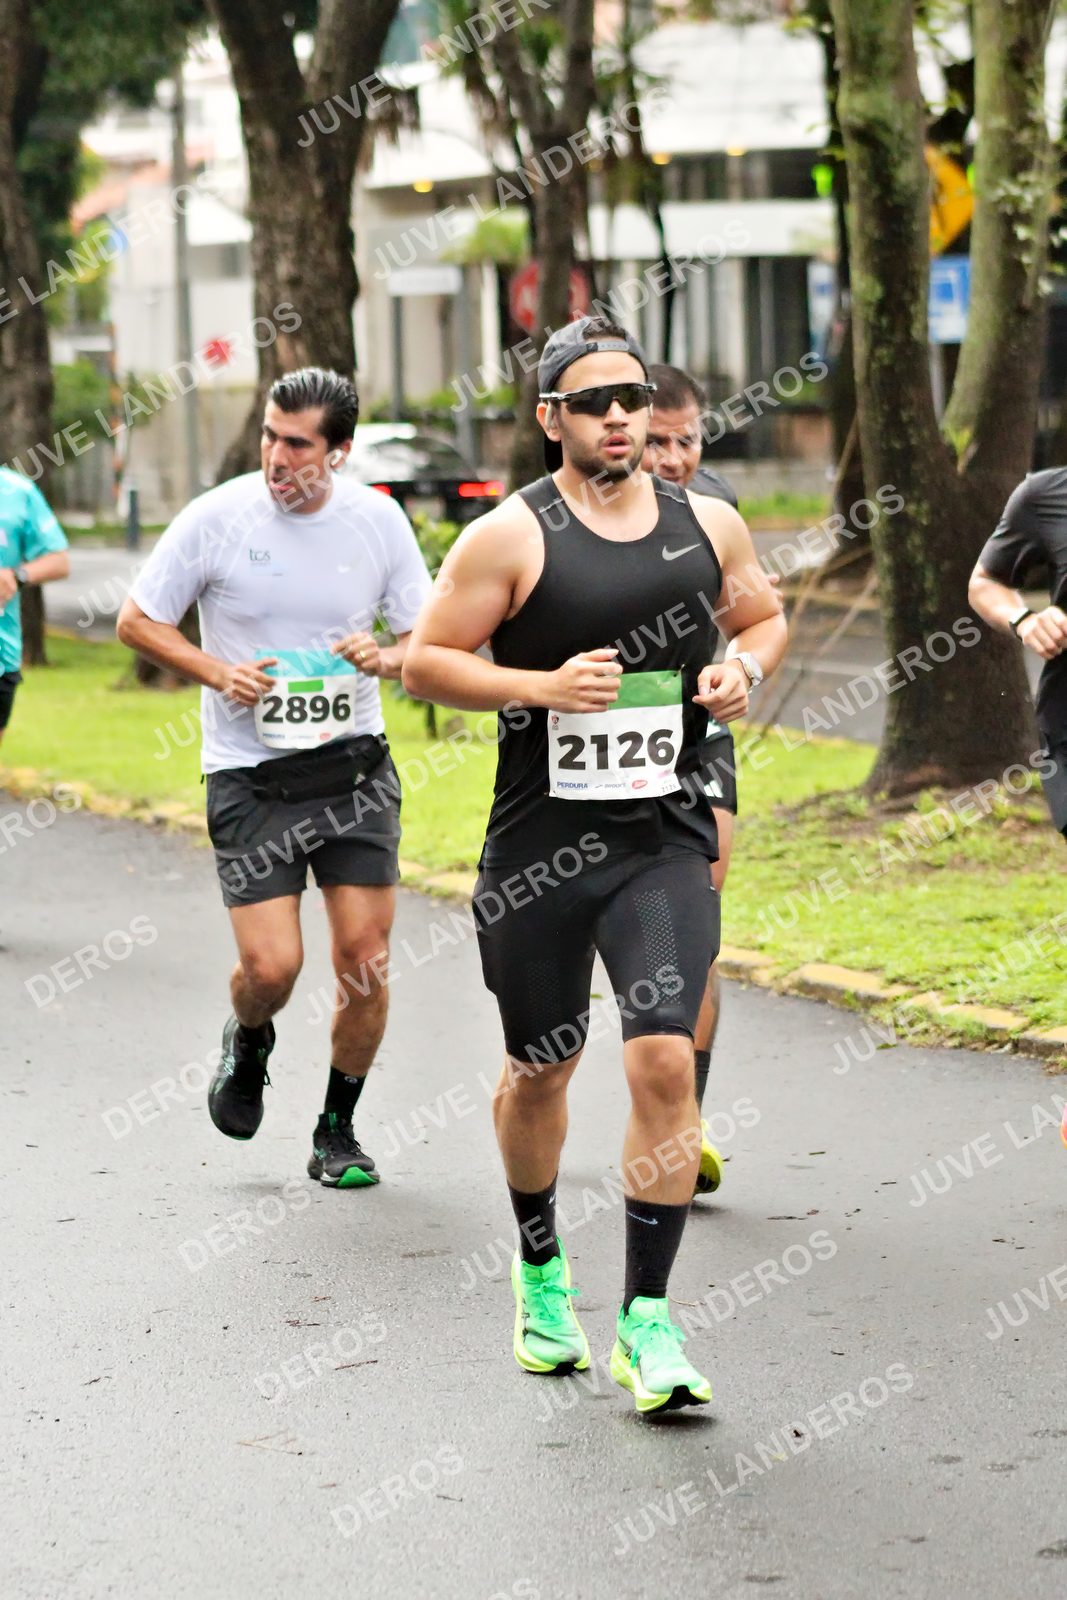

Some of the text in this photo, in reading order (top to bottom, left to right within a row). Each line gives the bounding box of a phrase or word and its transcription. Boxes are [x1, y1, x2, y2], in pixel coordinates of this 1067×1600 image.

[262, 694, 350, 724] 2896
[557, 729, 675, 771] 2126
[556, 781, 589, 790] PERDURA
